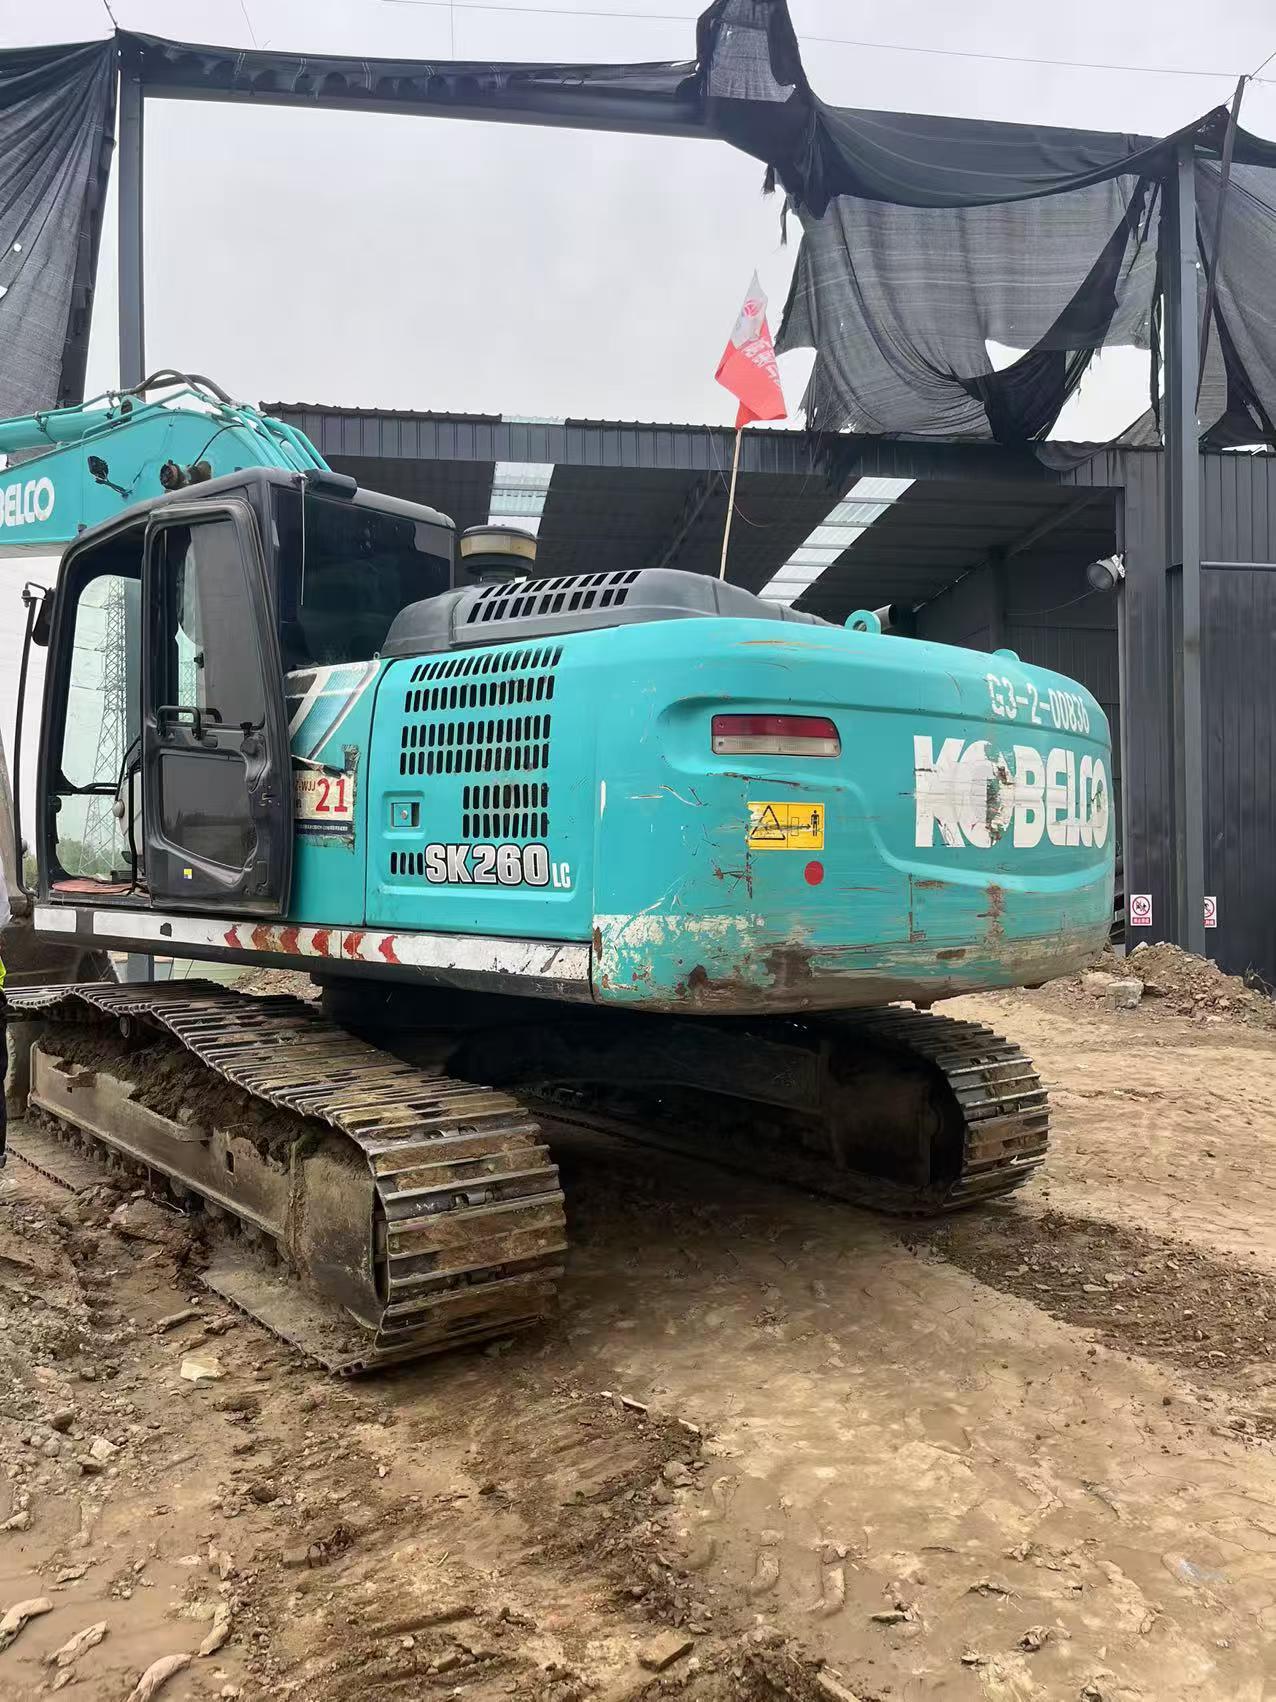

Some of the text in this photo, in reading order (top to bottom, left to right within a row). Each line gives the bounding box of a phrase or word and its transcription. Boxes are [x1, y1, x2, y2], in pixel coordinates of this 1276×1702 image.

[316, 778, 348, 813] 21
[914, 735, 1109, 849] KOBELCO
[424, 842, 571, 888] SK260 LC
